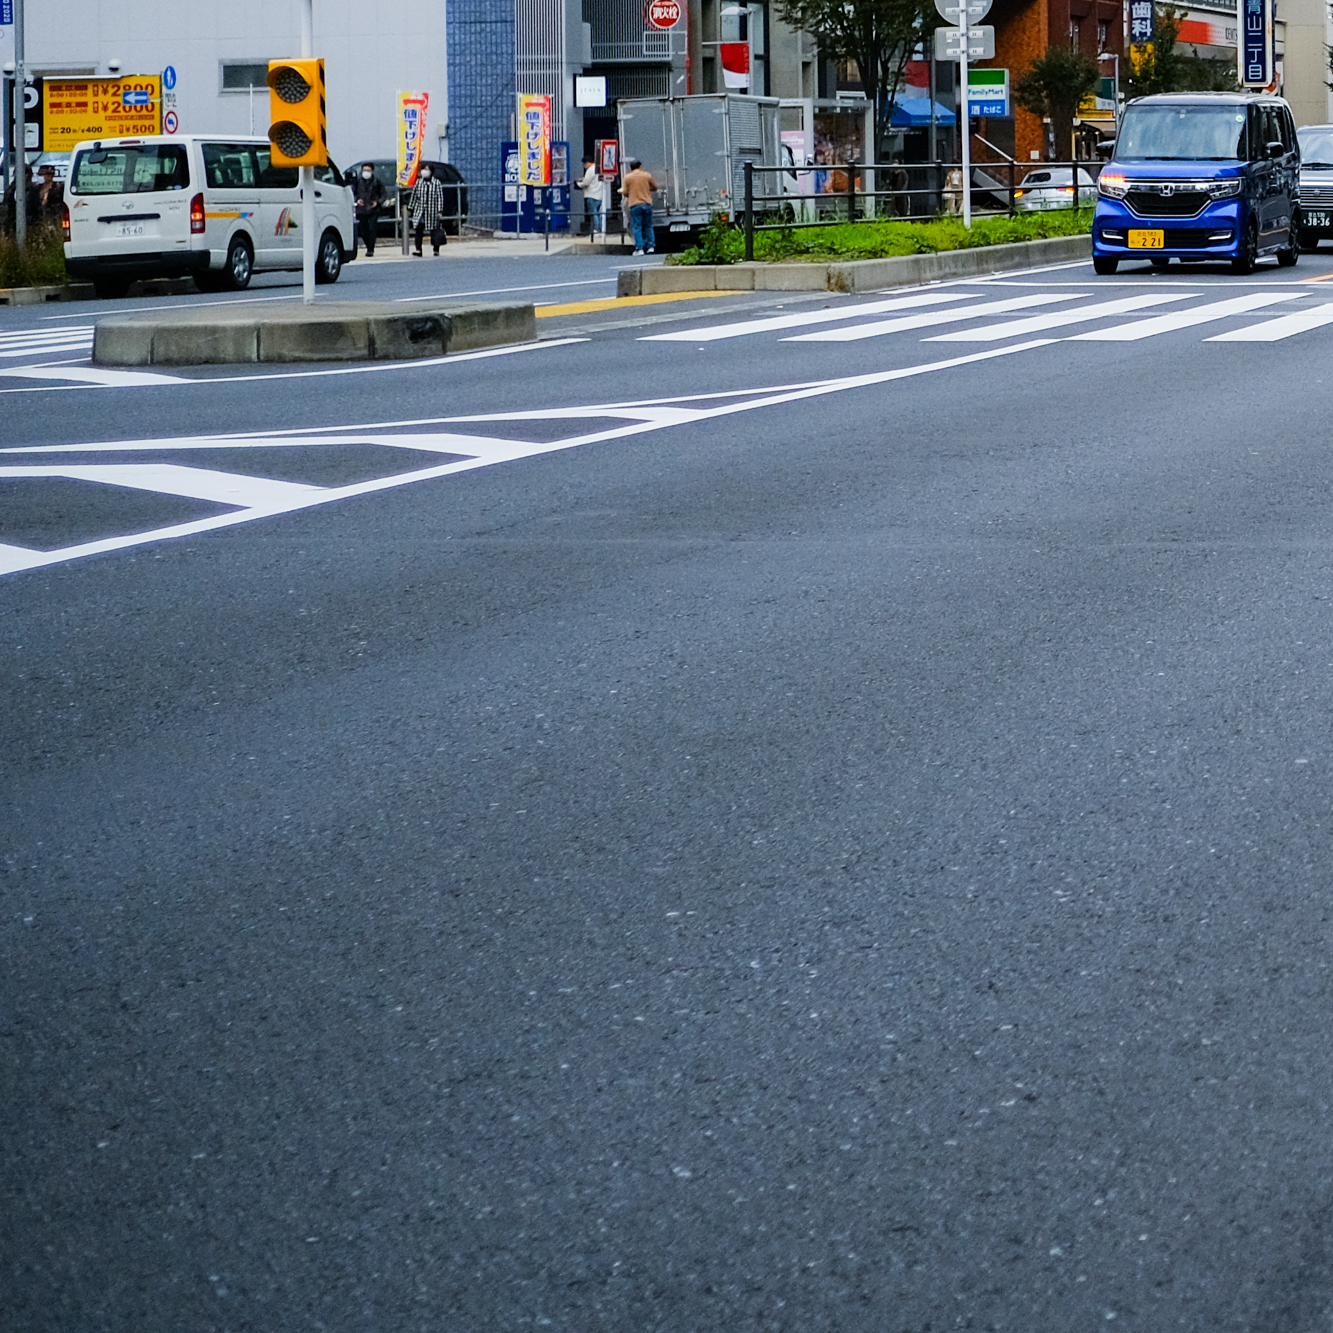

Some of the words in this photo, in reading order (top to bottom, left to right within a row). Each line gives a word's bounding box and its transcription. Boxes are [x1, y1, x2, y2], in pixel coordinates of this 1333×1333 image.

[652, 6, 678, 19] 消火栓
[1131, 1, 1153, 37] 歯科
[1246, 0, 1263, 80] 青山二丁目
[968, 88, 1004, 97] FamilyMart
[525, 111, 541, 180] 値下げしました
